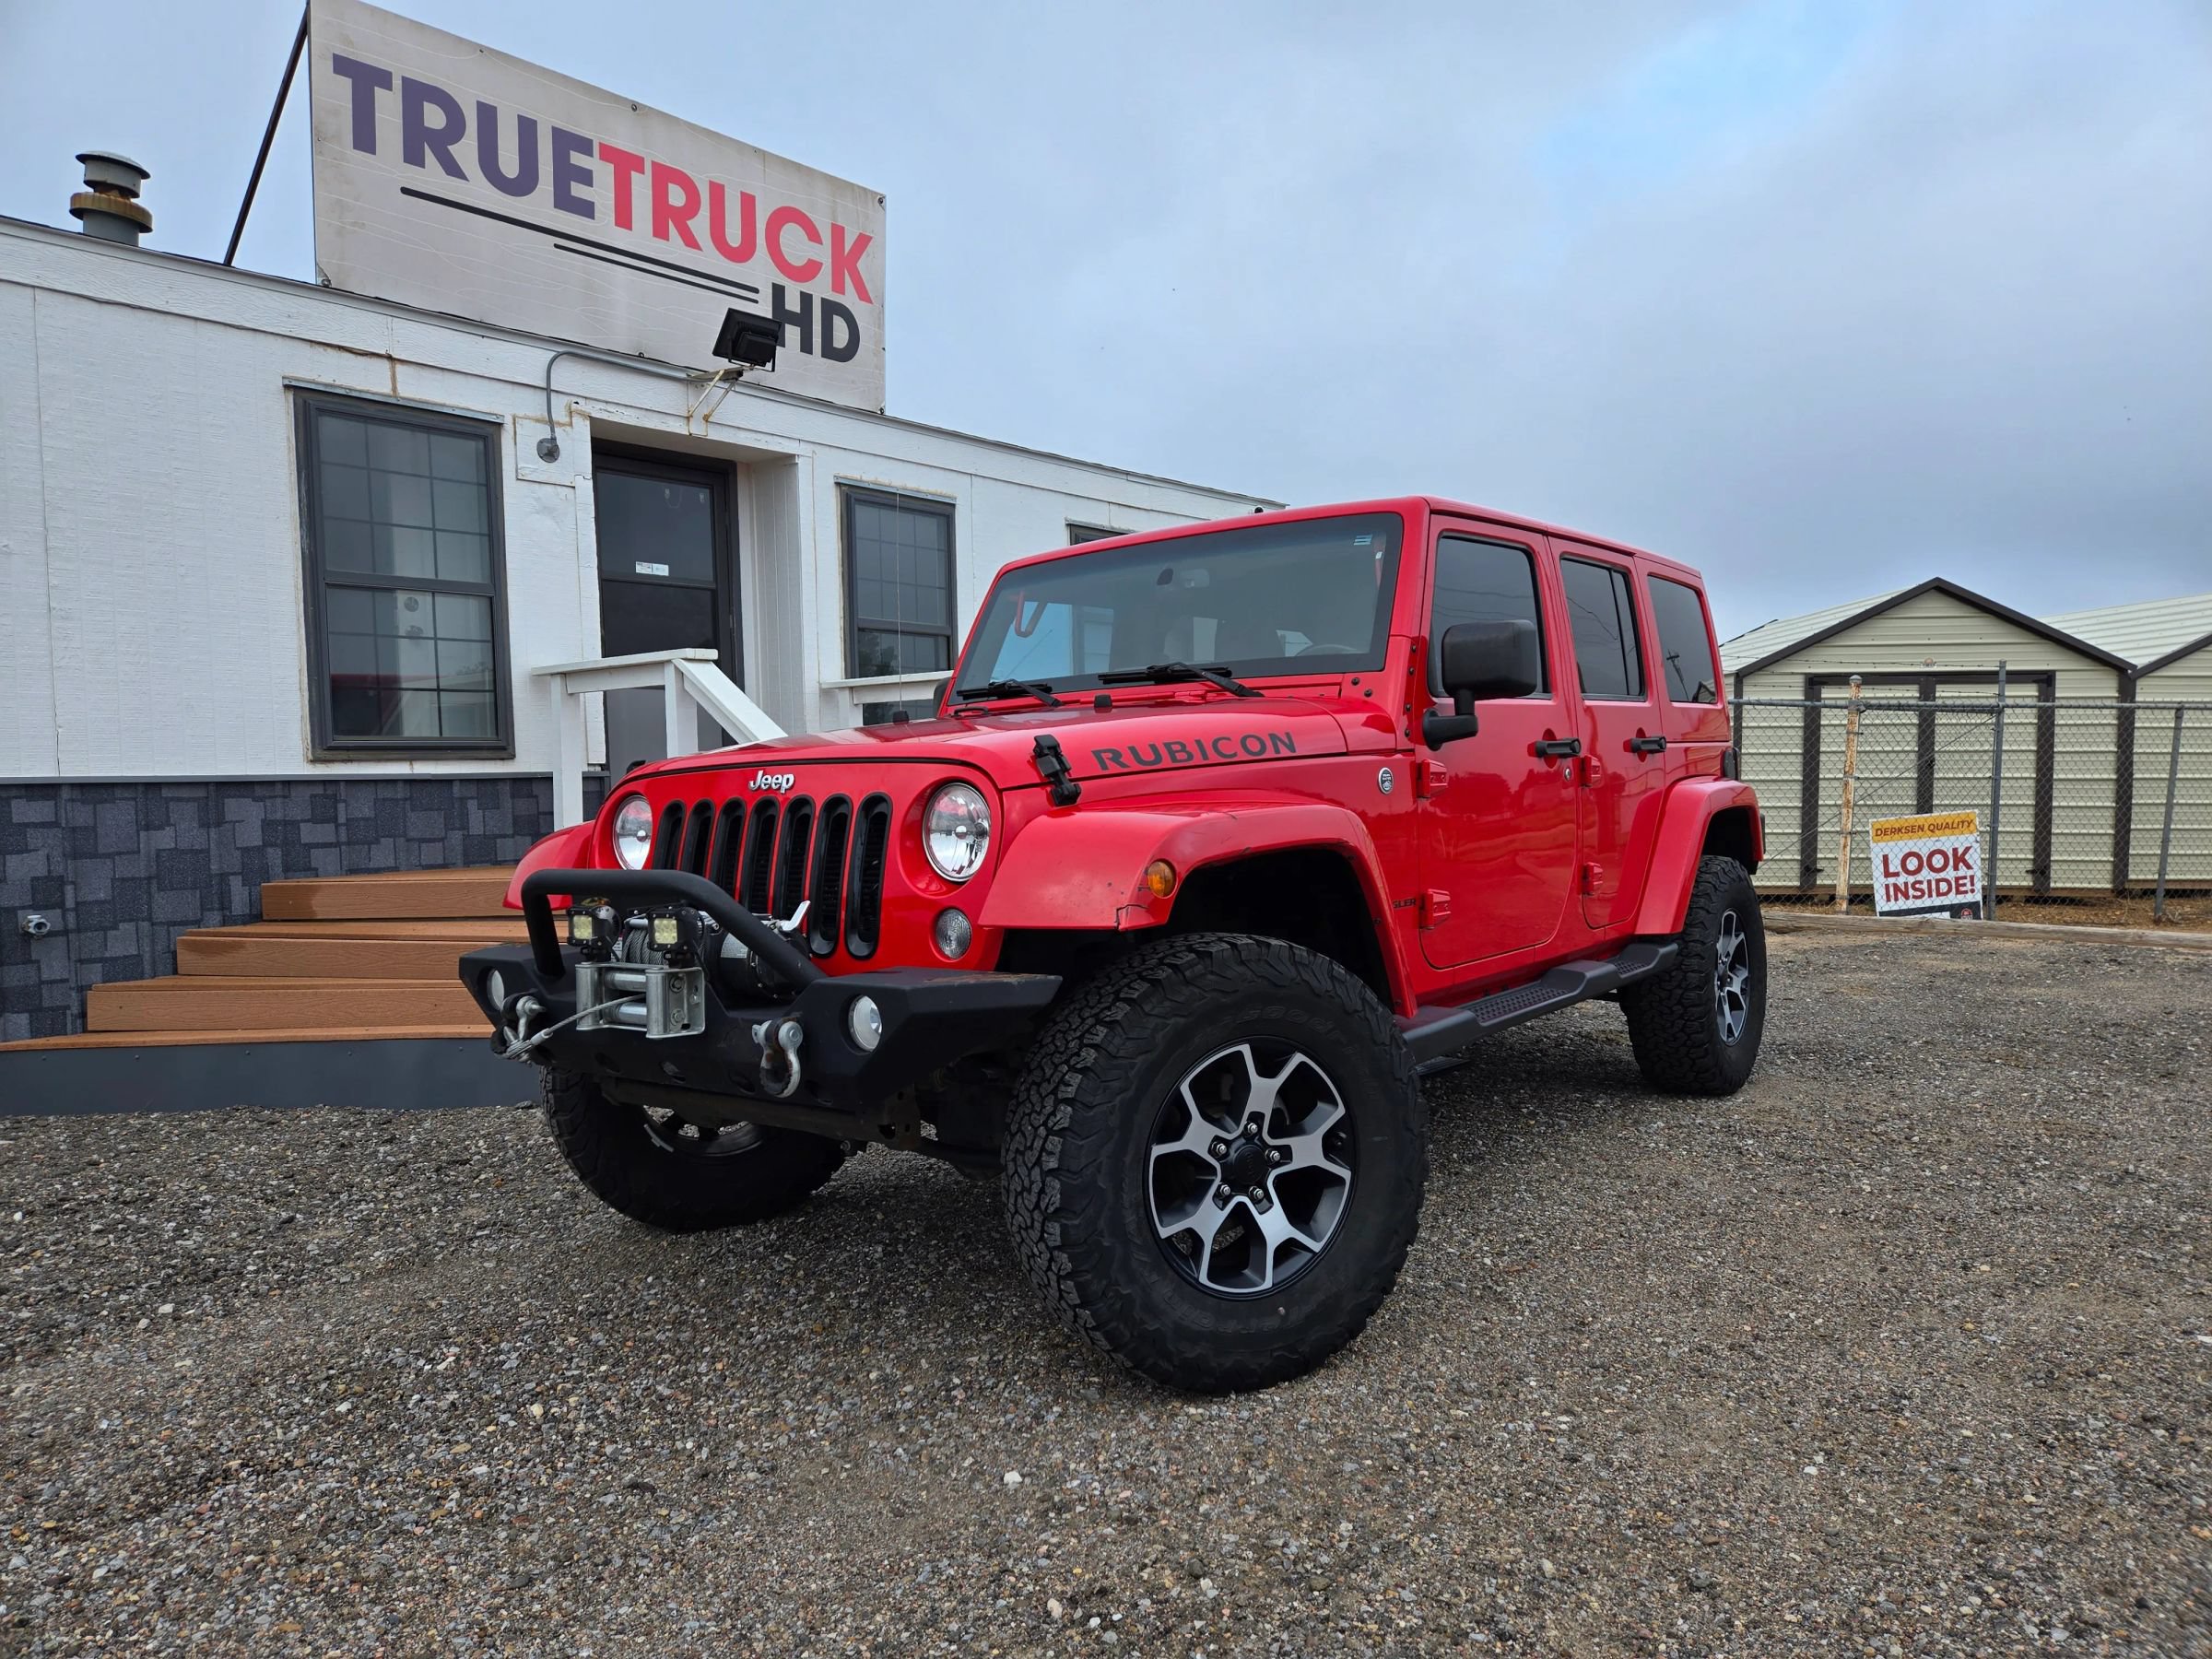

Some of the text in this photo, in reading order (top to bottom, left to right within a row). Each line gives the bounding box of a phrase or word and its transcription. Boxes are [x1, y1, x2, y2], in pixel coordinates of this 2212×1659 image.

[771, 283, 861, 363] HD
[1091, 732, 1297, 771] RUBICON
[748, 770, 794, 794] Jeep
[1875, 818, 1973, 837] DERKSEN QUALITY
[1882, 845, 1974, 878] LOOK
[1884, 875, 1976, 903] INSIDE!
[1392, 898, 1417, 909] GLER
